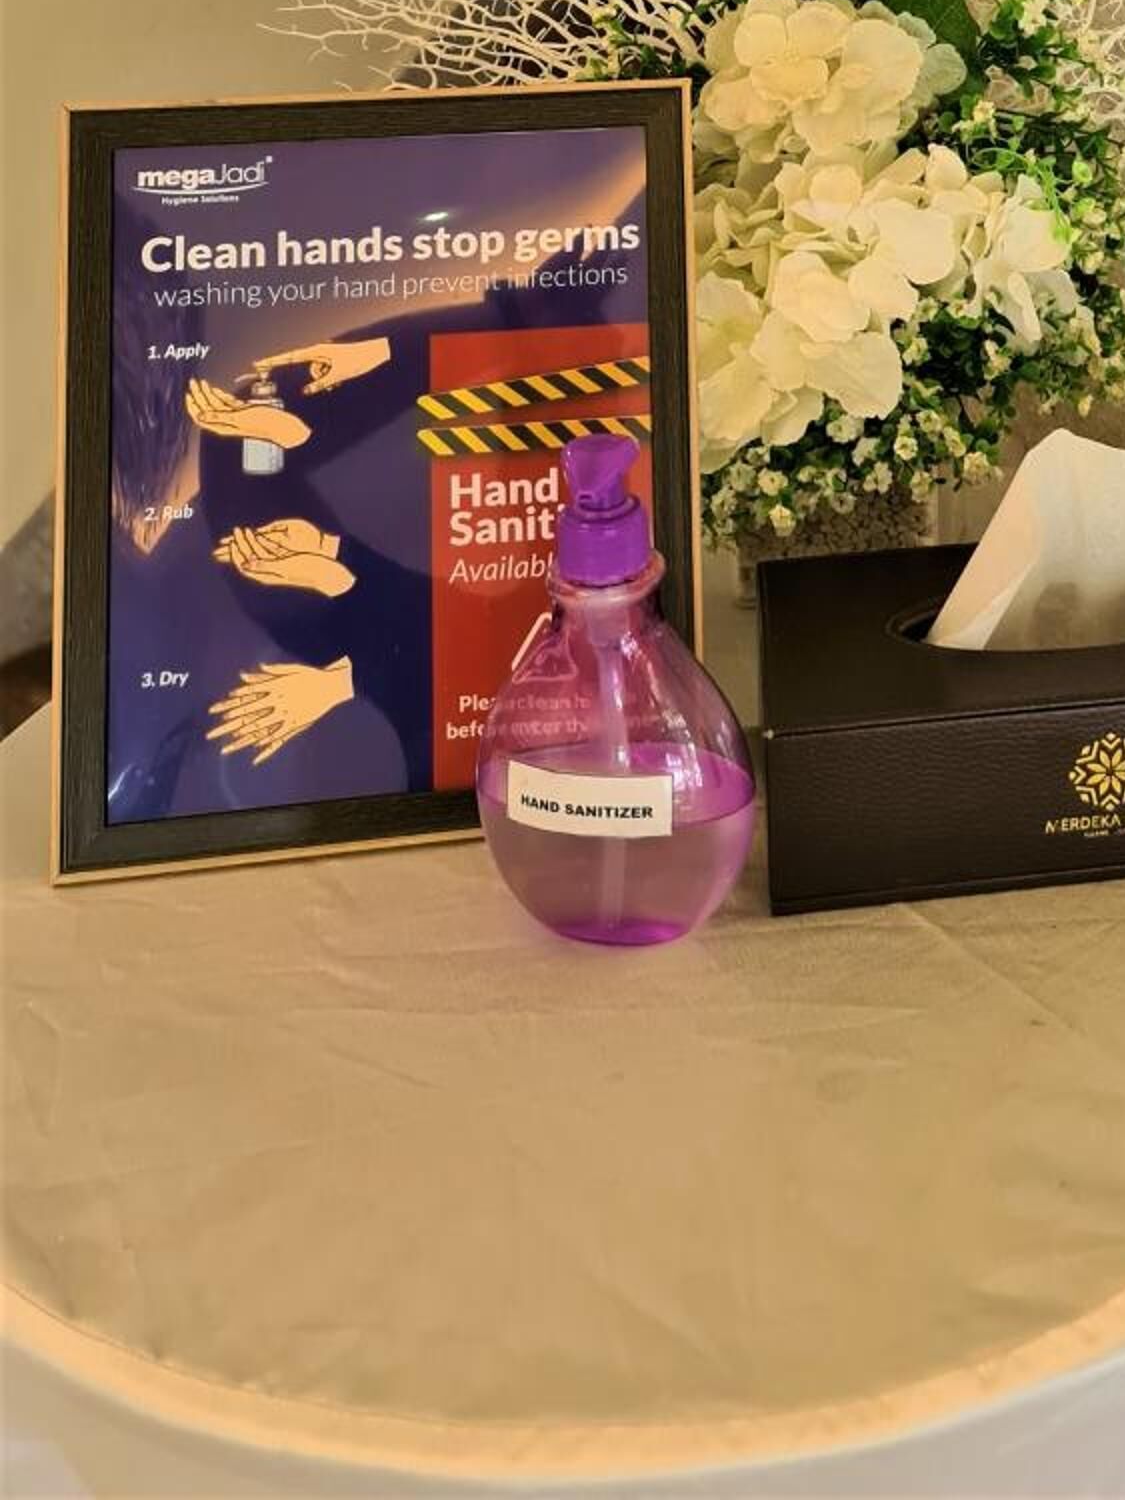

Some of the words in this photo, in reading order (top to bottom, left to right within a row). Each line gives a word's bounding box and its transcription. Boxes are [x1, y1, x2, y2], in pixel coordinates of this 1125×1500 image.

[141, 234, 266, 273] Clean
[277, 226, 403, 266] hands
[413, 226, 505, 264] stop
[514, 223, 640, 263] germs
[154, 281, 263, 308] washing
[268, 283, 326, 304] your
[334, 273, 396, 298] hand
[403, 272, 501, 299] prevent
[507, 262, 629, 292] infections
[148, 346, 161, 359] 1.
[164, 342, 210, 361] Apply
[450, 467, 559, 509] Hand
[144, 507, 158, 521] 2.
[162, 504, 194, 520] Rub
[450, 506, 566, 547] Sanit
[141, 673, 155, 688] 3.
[159, 671, 189, 687] Dry
[521, 795, 560, 813] HAND
[565, 806, 654, 818] SANITIZER
